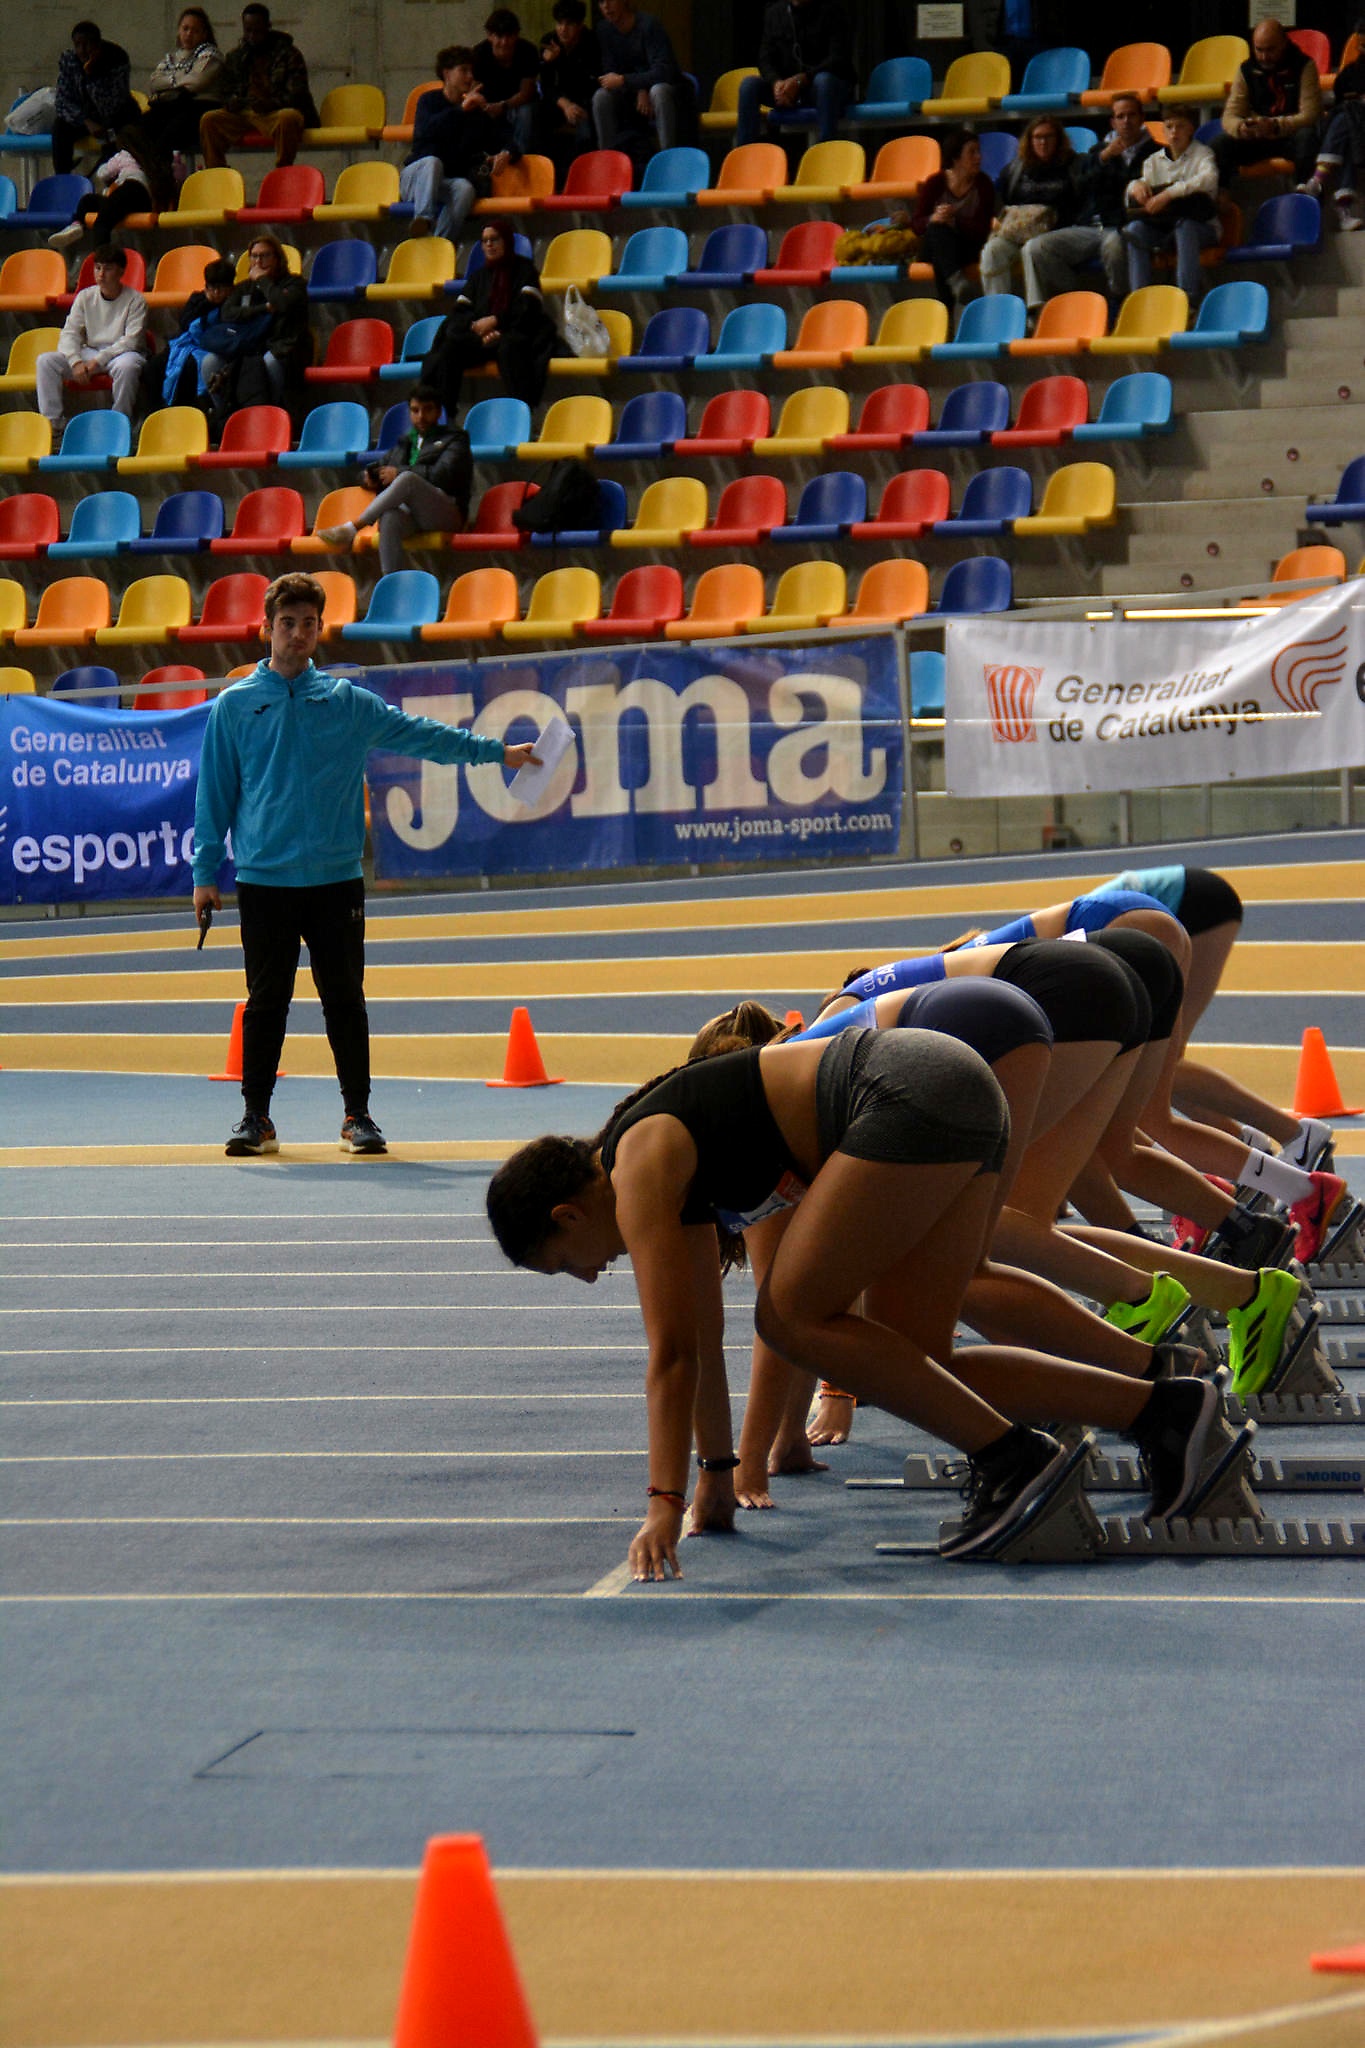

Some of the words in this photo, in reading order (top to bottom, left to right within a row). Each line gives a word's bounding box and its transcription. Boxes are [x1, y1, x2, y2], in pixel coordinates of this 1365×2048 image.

[1055, 665, 1234, 706] Generalitat
[1048, 713, 1084, 742] de
[1095, 698, 1265, 742] Catalunya
[9, 725, 168, 754] Generalitat
[11, 760, 47, 787] de
[52, 756, 192, 789] Catalunya
[674, 812, 893, 843] www.joma-sport.com
[1305, 1471, 1362, 1482] MONDO
